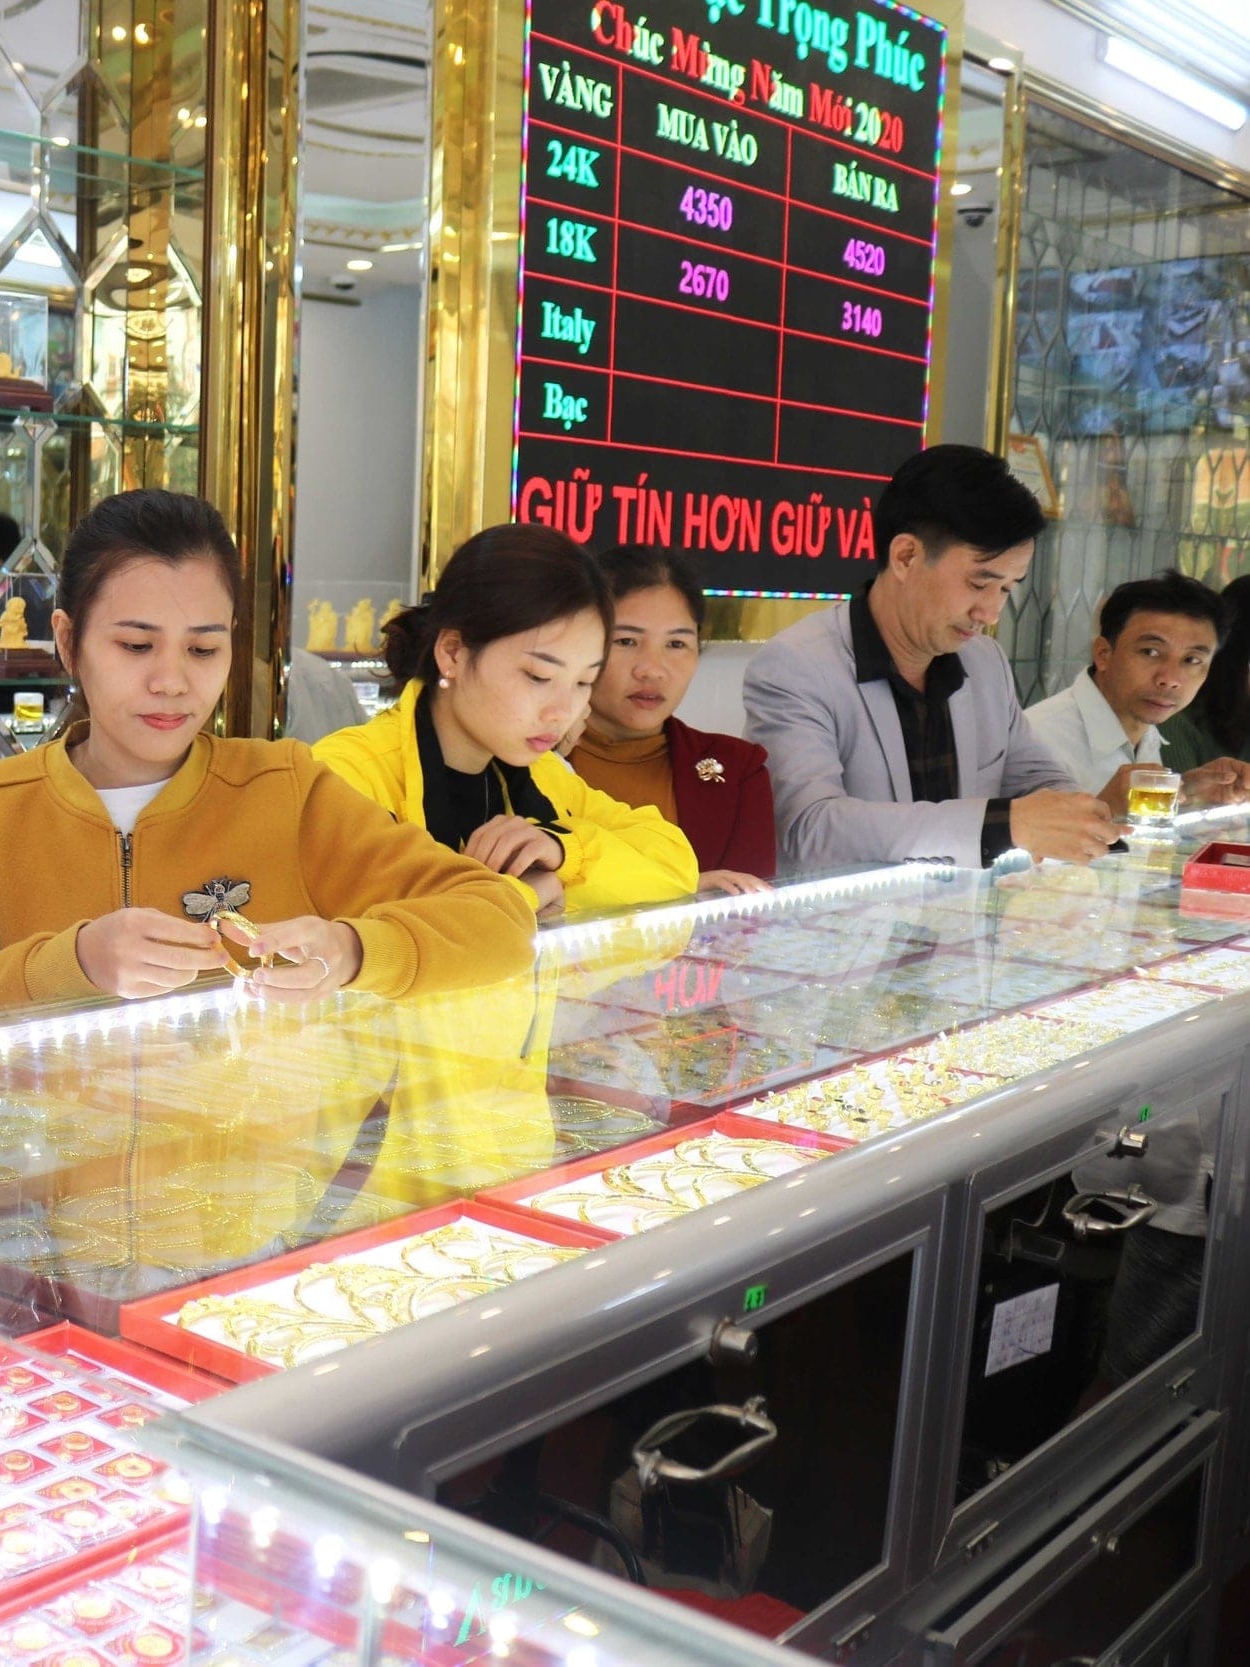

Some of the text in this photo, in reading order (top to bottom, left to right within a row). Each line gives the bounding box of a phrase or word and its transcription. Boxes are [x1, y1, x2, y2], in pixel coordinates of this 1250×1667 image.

[590, 0, 664, 65] Chúc
[751, 59, 804, 118] Năm
[809, 82, 853, 136] Mới
[854, 102, 904, 152] 2020
[855, 11, 926, 92] Phúc
[538, 62, 613, 118] VÀNG
[657, 103, 758, 166] MUA VÀO
[547, 140, 599, 188] 24K
[832, 160, 899, 212] BÁN RA
[679, 186, 733, 231] 4350
[546, 217, 598, 263] 18K
[843, 238, 886, 277] 4520
[679, 260, 729, 302] 2670
[541, 302, 596, 354] Italy
[841, 302, 882, 338] 3140
[543, 382, 588, 429] Bạc
[519, 468, 876, 560] GIỮ TÍN HƠN GIỮ VÀ
